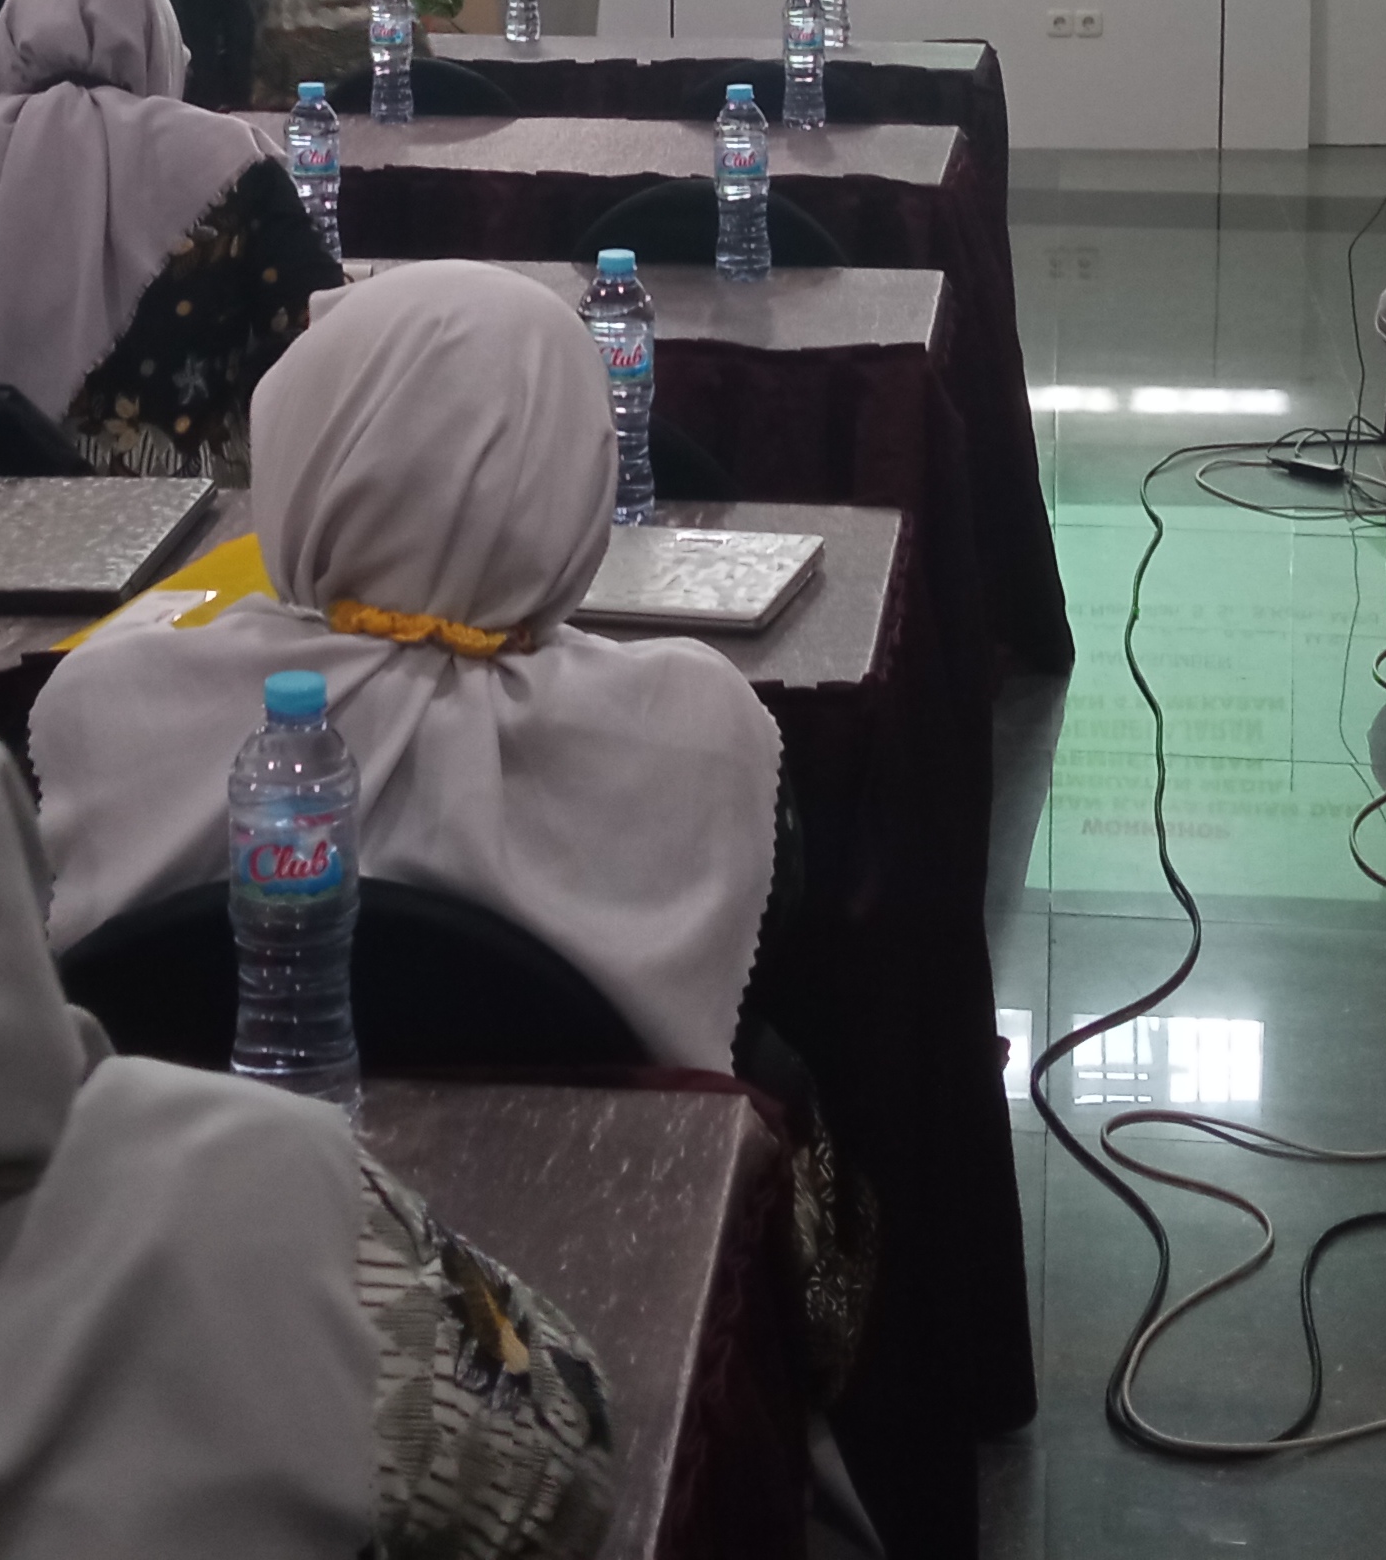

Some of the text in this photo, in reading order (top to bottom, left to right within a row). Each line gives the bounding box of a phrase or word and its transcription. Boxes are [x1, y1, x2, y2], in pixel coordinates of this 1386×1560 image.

[298, 149, 332, 166] Club
[722, 150, 756, 168] Club
[249, 839, 329, 884] Club
